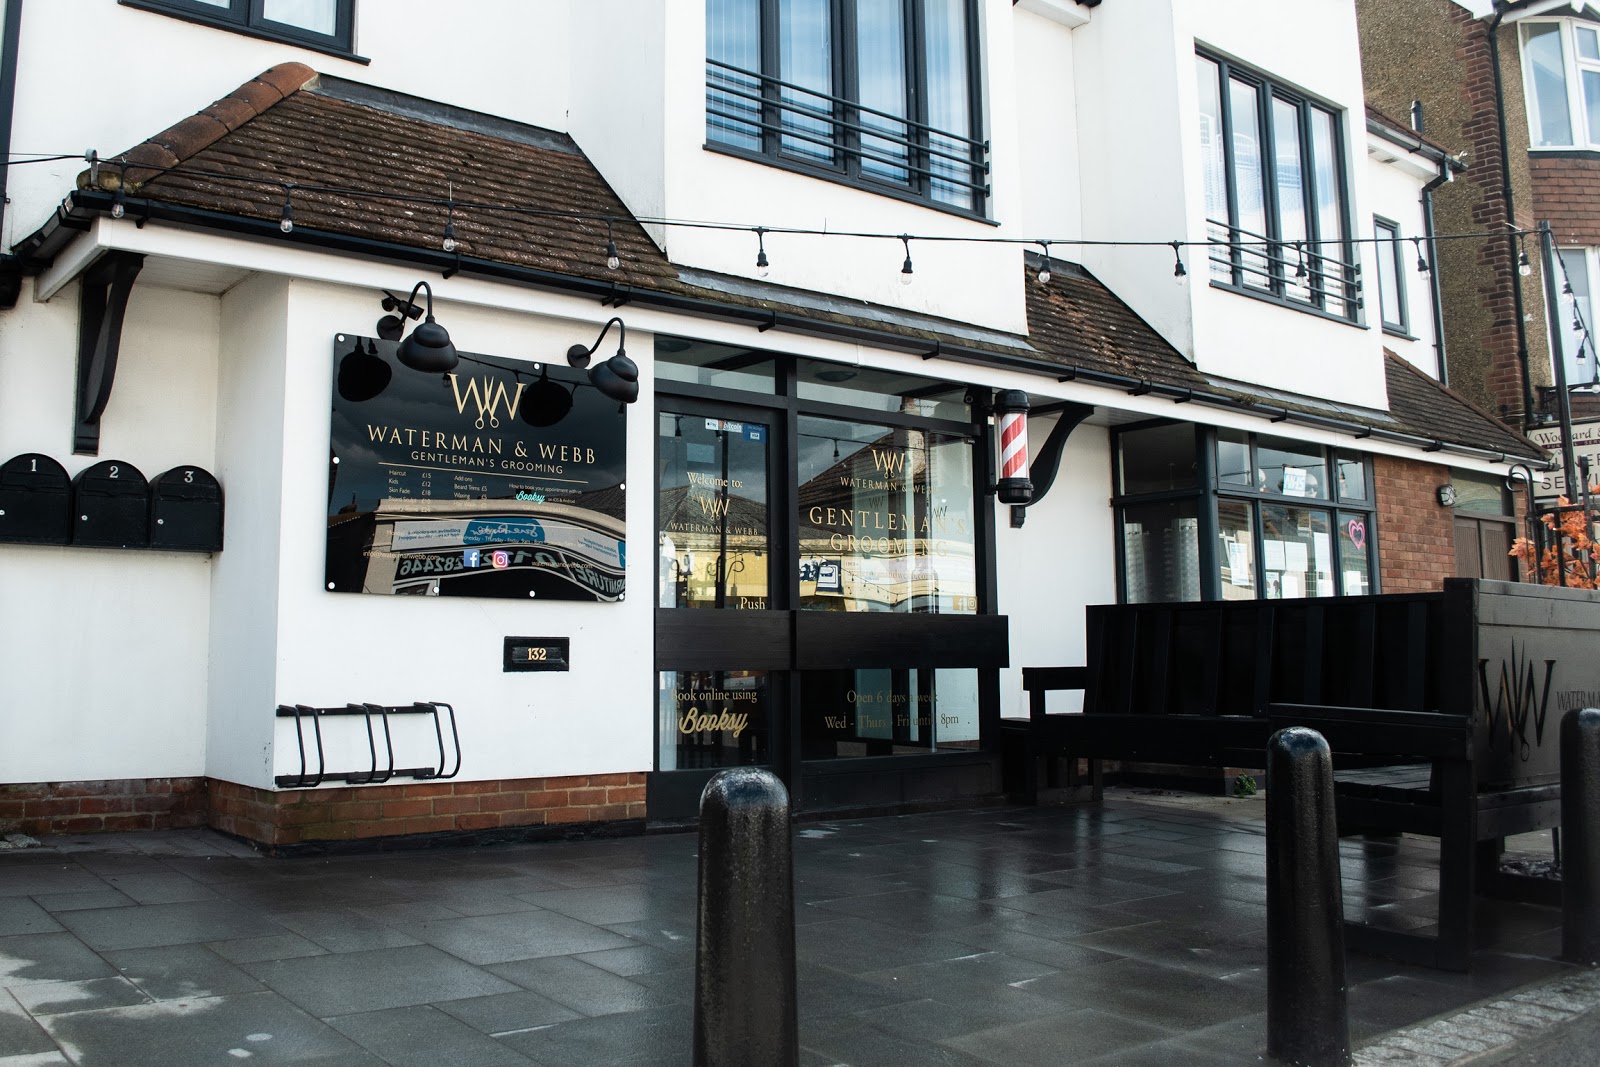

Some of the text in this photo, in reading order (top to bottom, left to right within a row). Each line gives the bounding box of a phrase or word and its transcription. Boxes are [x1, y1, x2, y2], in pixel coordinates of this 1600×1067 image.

[724, 421, 742, 431] bitcoin
[367, 424, 595, 464] WATERMAN & WEBB
[31, 459, 37, 472] 1
[411, 450, 563, 475] GENTLEMAN'S GROOMING
[109, 465, 119, 479] 2
[184, 470, 194, 483] 3
[388, 469, 407, 477] Haircut
[454, 483, 468, 491] Beard
[468, 484, 480, 492] Trims
[687, 472, 743, 488] Welcome to:
[840, 476, 897, 491] WATERMAN
[453, 492, 471, 500] Waxing
[516, 490, 546, 505] Booksy
[670, 521, 758, 536] WATERMAN & WEBB
[740, 596, 766, 610] Push
[527, 647, 547, 661] 132
[671, 687, 757, 704] Book online using
[846, 689, 873, 707] Open
[876, 689, 883, 701] 6
[886, 689, 906, 707] days
[679, 707, 748, 738] Booksy
[824, 714, 847, 729] Wed
[860, 714, 887, 729] Thurs
[897, 713, 910, 727] Fri
[940, 712, 959, 729] 8pm
